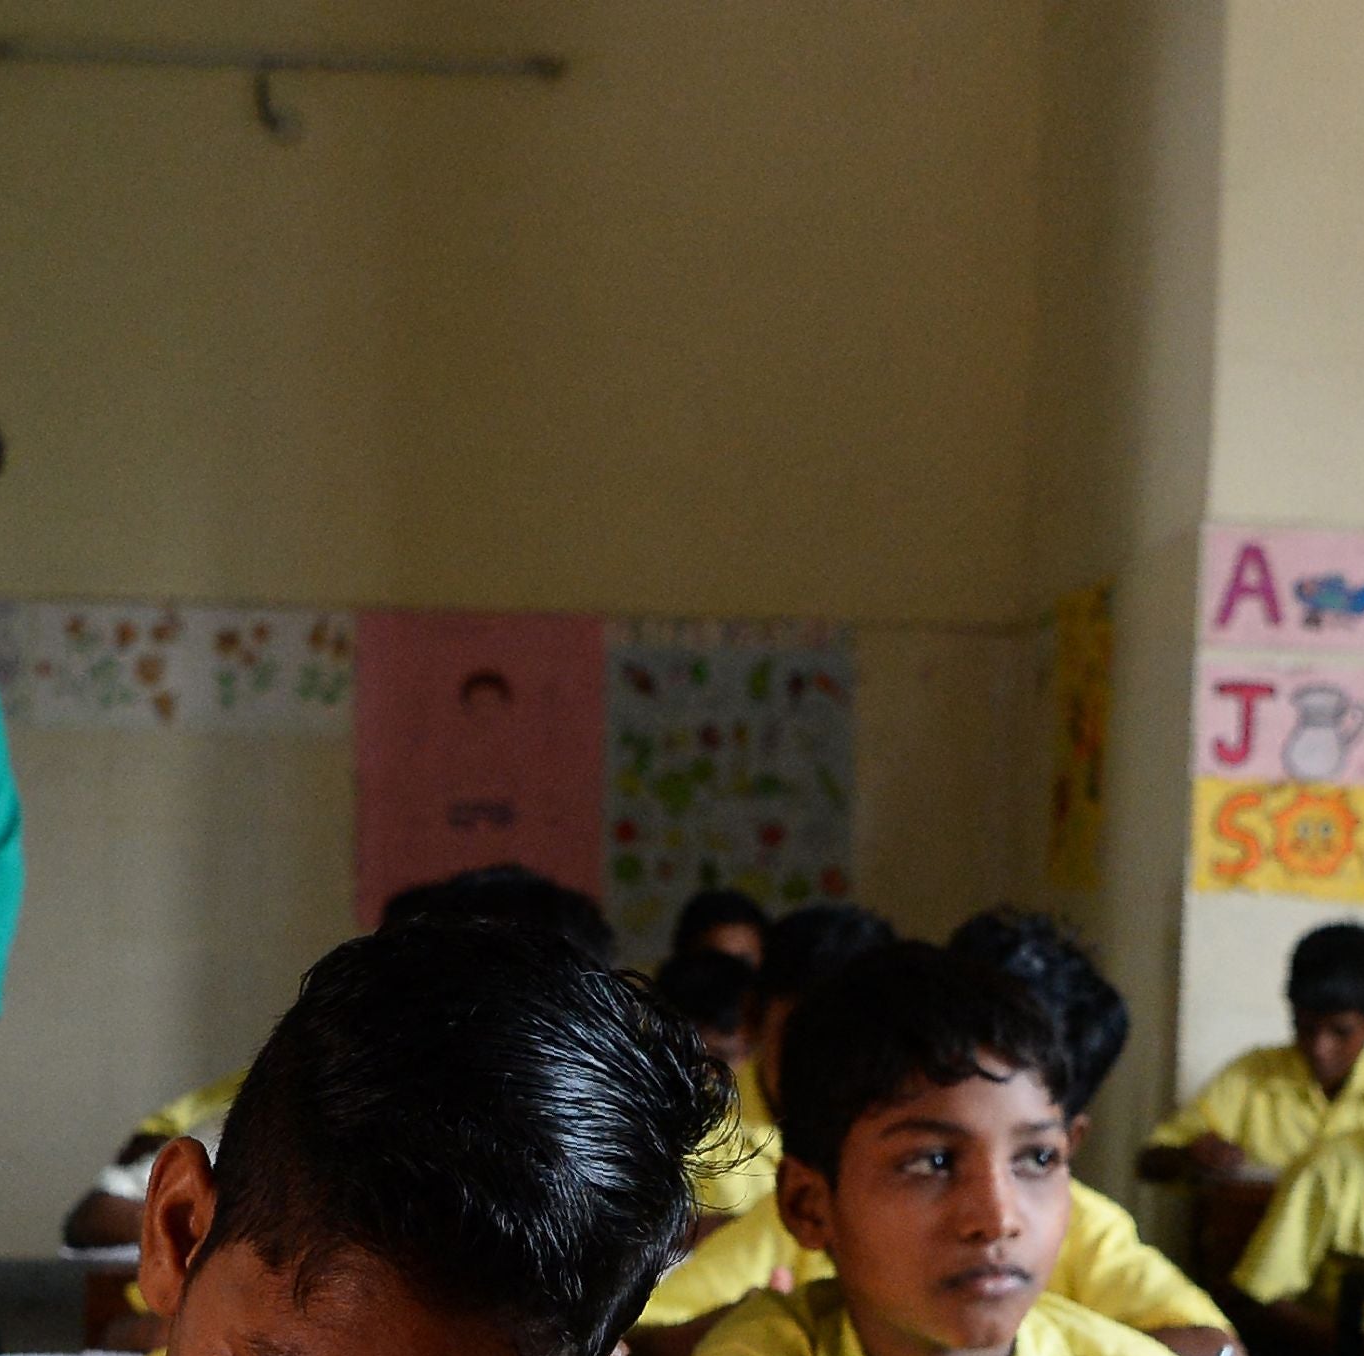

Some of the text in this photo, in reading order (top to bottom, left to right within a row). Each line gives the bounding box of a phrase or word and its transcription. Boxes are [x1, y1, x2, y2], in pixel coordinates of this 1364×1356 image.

[1214, 542, 1284, 629] A
[1212, 681, 1275, 766] J
[1213, 792, 1265, 878] S
